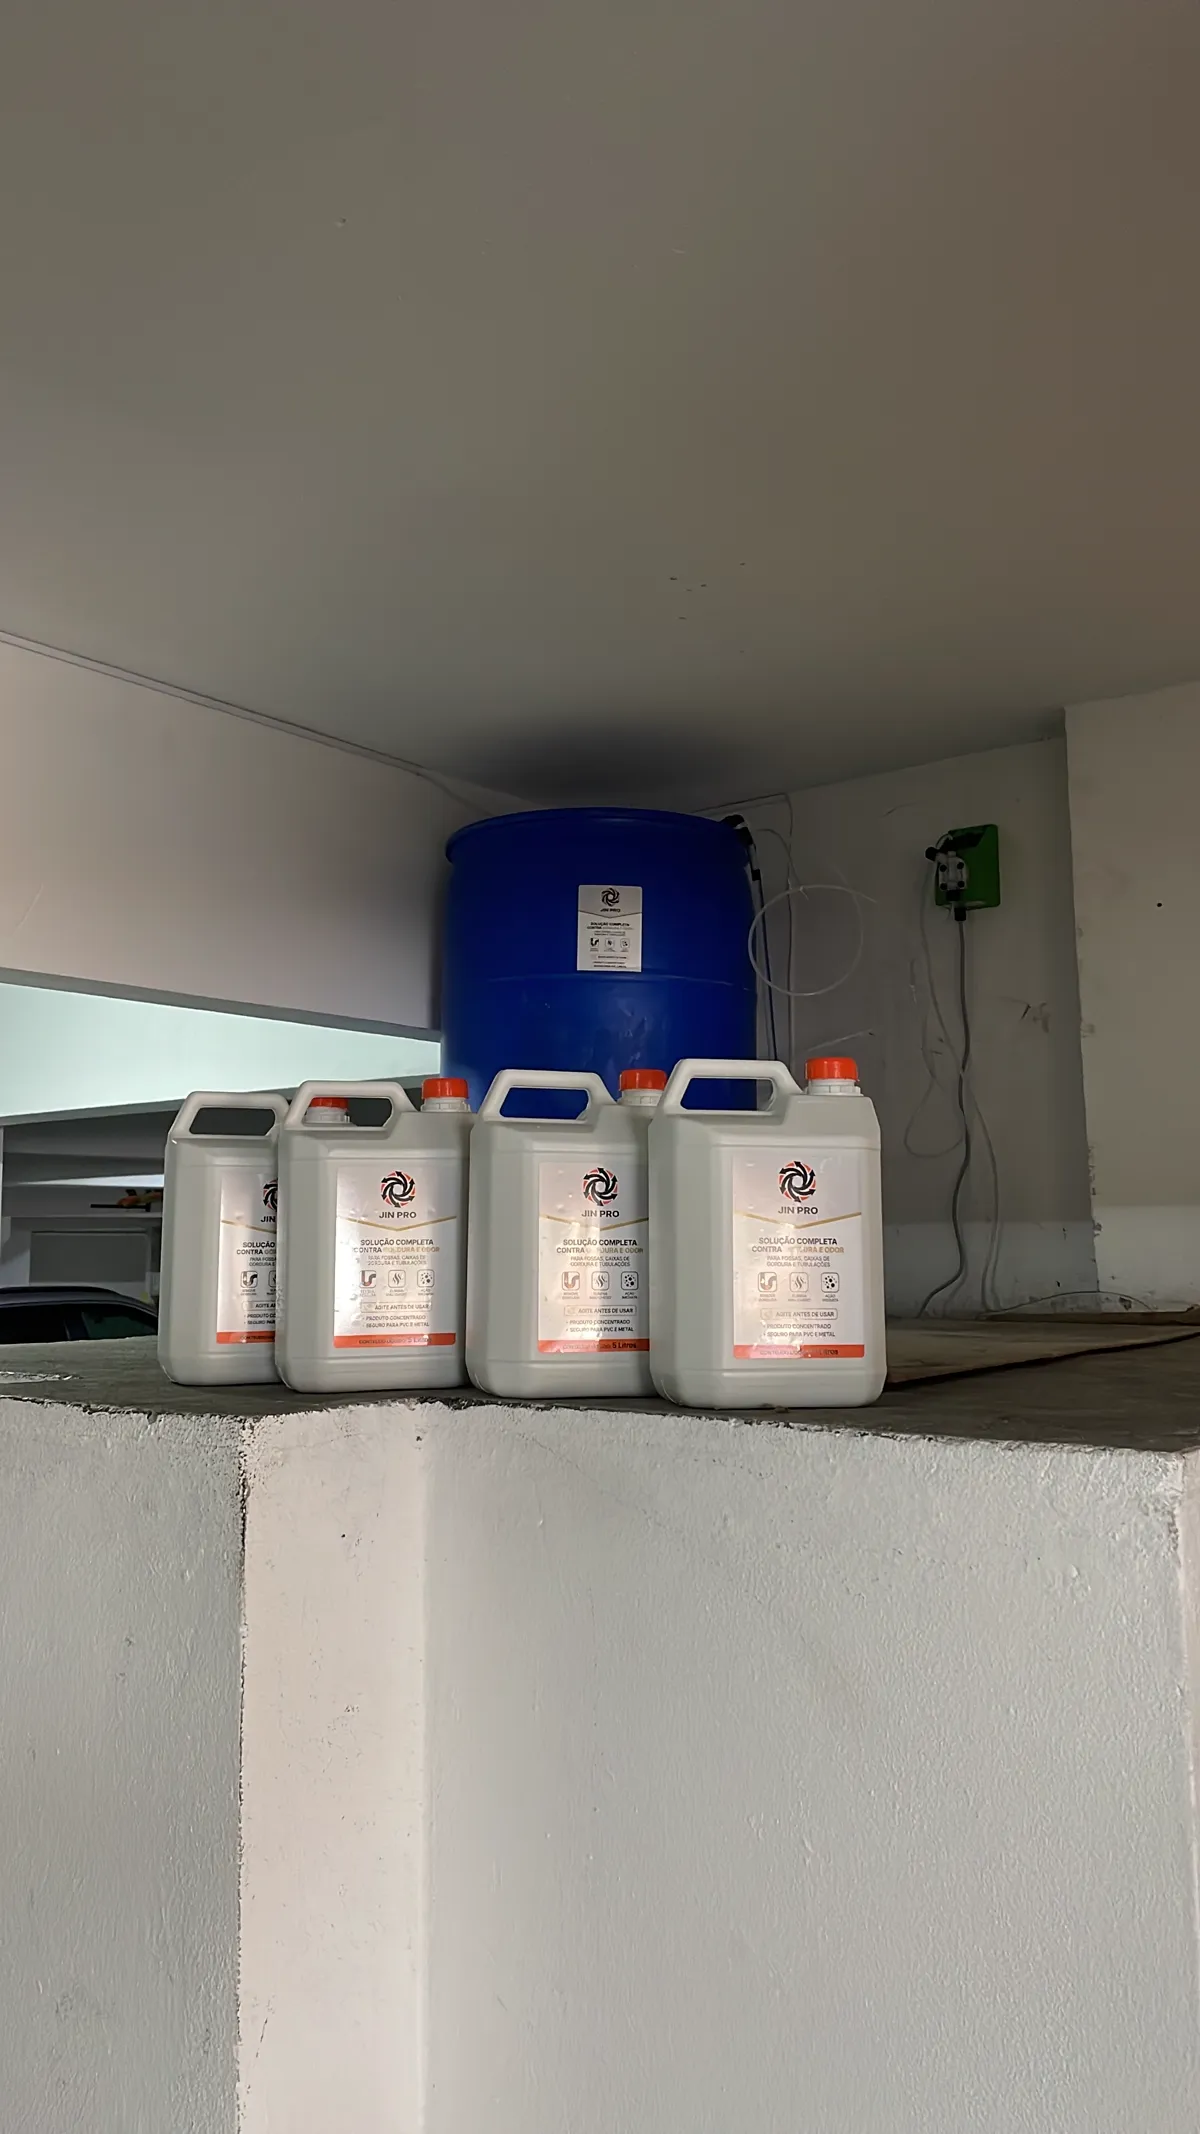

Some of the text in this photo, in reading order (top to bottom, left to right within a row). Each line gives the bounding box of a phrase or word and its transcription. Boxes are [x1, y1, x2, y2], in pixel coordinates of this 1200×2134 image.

[361, 1238, 394, 1246] SOLUÇÃO
[563, 1238, 597, 1246] SOLUÇÃO
[759, 1236, 795, 1245] SOLUÇÃO
